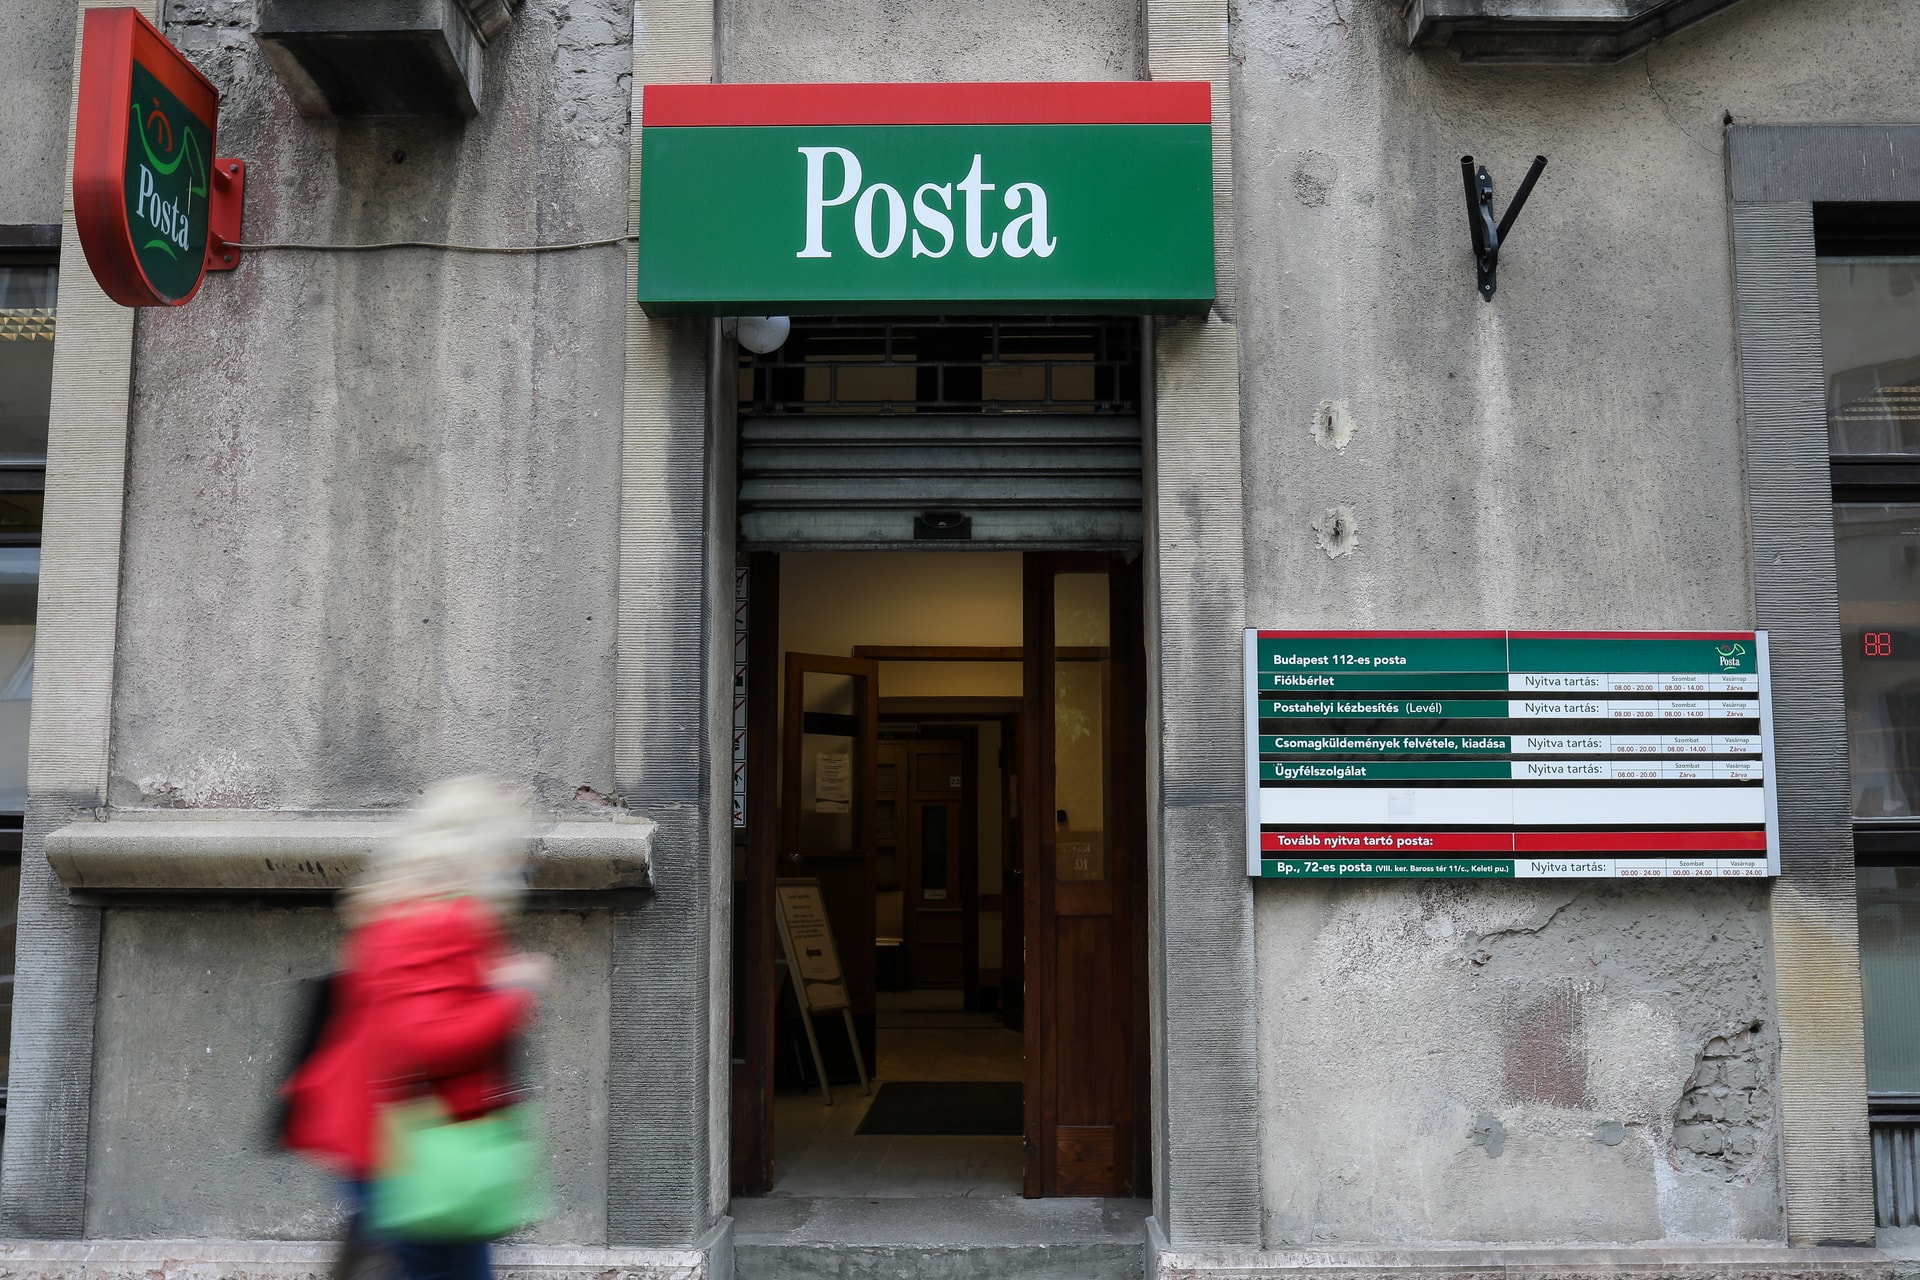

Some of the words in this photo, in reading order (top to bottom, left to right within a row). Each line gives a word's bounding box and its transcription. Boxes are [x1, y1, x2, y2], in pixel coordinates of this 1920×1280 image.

[136, 164, 190, 251] Posta
[796, 147, 1057, 259] Posta
[1864, 632, 1891, 656] 88
[1274, 655, 1328, 666] Budapest
[1333, 656, 1370, 665] 112-es
[1374, 656, 1406, 666] posta
[1720, 656, 1740, 666] Posta
[1274, 676, 1334, 686] Fiókbérlet
[1525, 676, 1561, 687] Nyitva
[1564, 676, 1599, 686] tartás:
[1274, 703, 1333, 713] Postahelyi
[1337, 703, 1399, 713] kézbesítés
[1406, 703, 1442, 714] (Levél)
[1525, 703, 1561, 714] Nyitva
[1564, 703, 1599, 712] tartás:
[1275, 738, 1400, 750] Csomagküldemények
[1403, 738, 1458, 750] felvétele,
[1462, 738, 1505, 749] kiadása
[1528, 738, 1564, 749] Nyitva
[1567, 738, 1602, 747] tartás:
[1275, 764, 1366, 777] Ügyfélszolgálat
[1528, 764, 1564, 774] Nyitva
[1567, 764, 1602, 774] tartás:
[1278, 836, 1320, 846] Tovább
[1324, 836, 1360, 847] nyitva
[1363, 836, 1393, 846] tartó
[1397, 837, 1433, 848] posta:
[1277, 863, 1300, 873] Bp.,
[1304, 863, 1336, 872] 72-es
[1339, 863, 1372, 874] posta
[1376, 865, 1392, 873] (VIII.
[1449, 865, 1469, 873] 11/c.,
[1495, 865, 1508, 873] pu.)
[1531, 862, 1567, 873] Nyitva
[1571, 862, 1606, 872] tartás:
